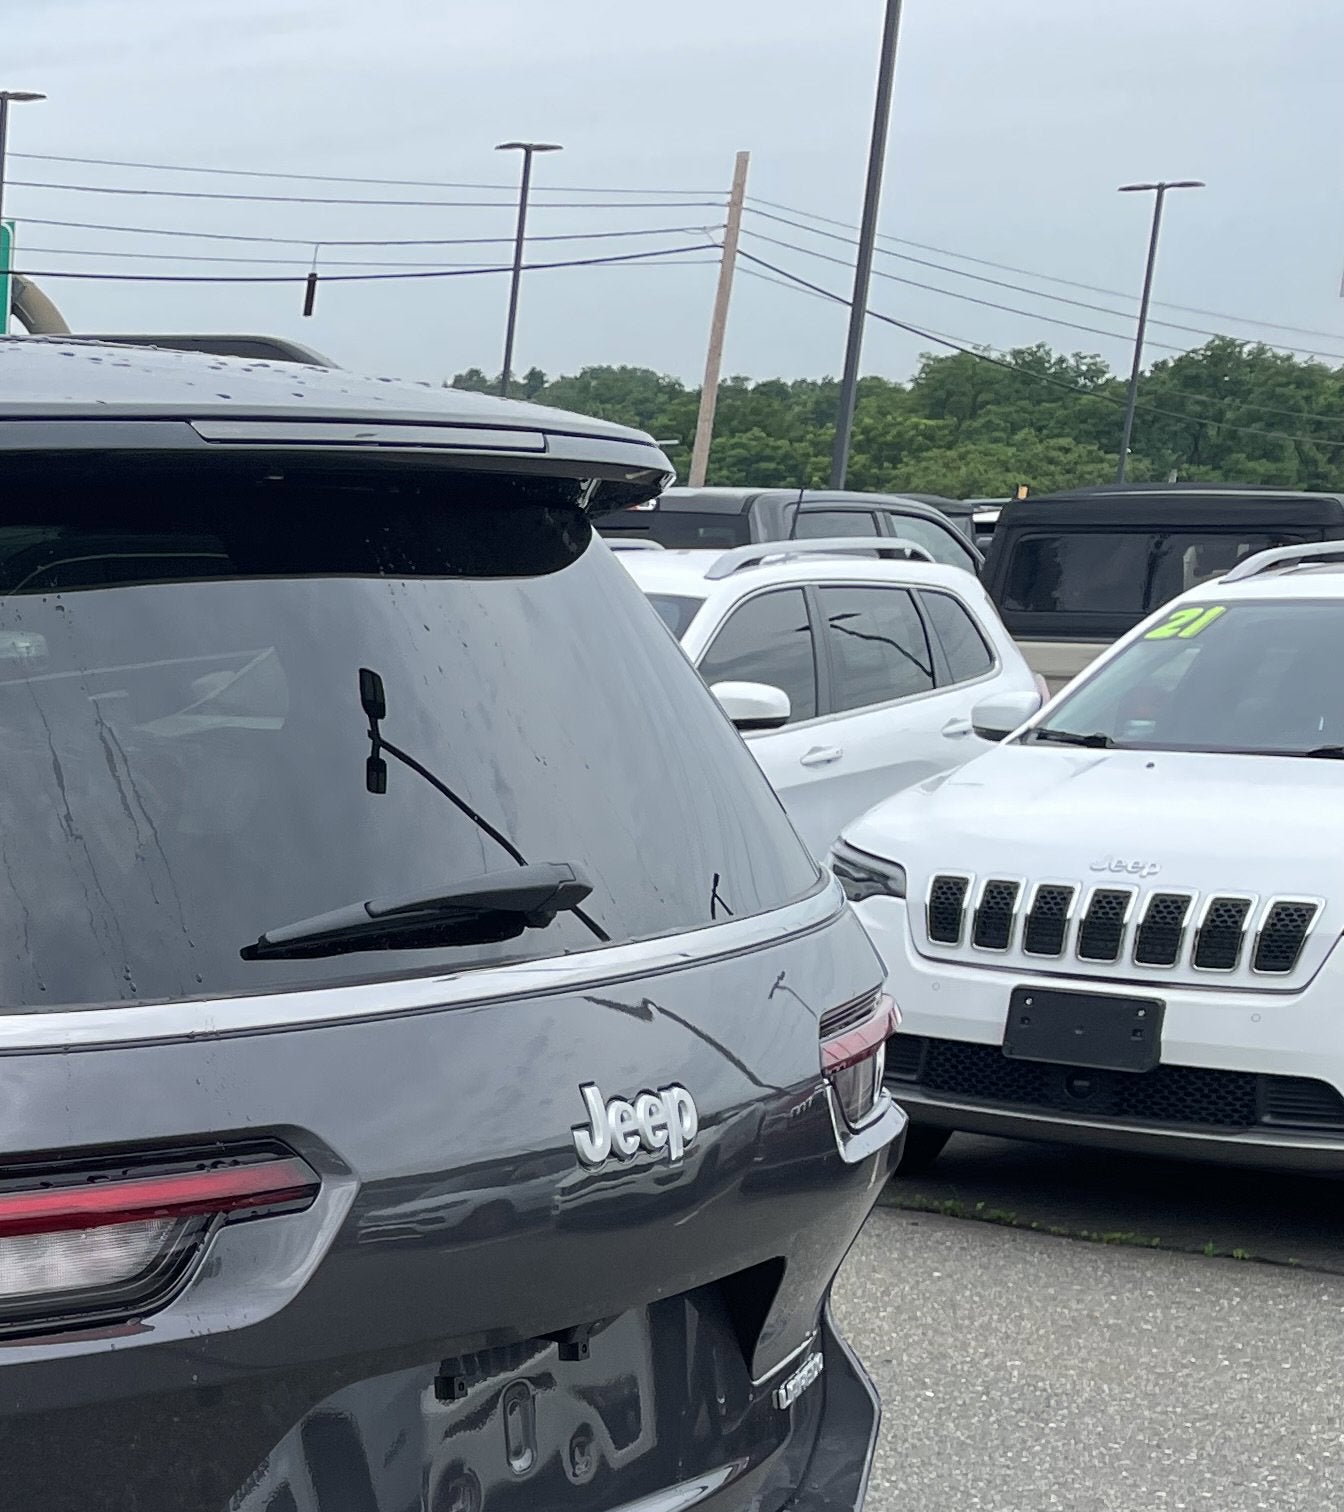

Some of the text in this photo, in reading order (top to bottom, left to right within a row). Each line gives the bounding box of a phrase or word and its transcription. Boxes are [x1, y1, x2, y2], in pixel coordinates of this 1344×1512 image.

[1143, 606, 1227, 641] 21
[1089, 854, 1162, 879] Jeep
[570, 1081, 699, 1168] Jeep
